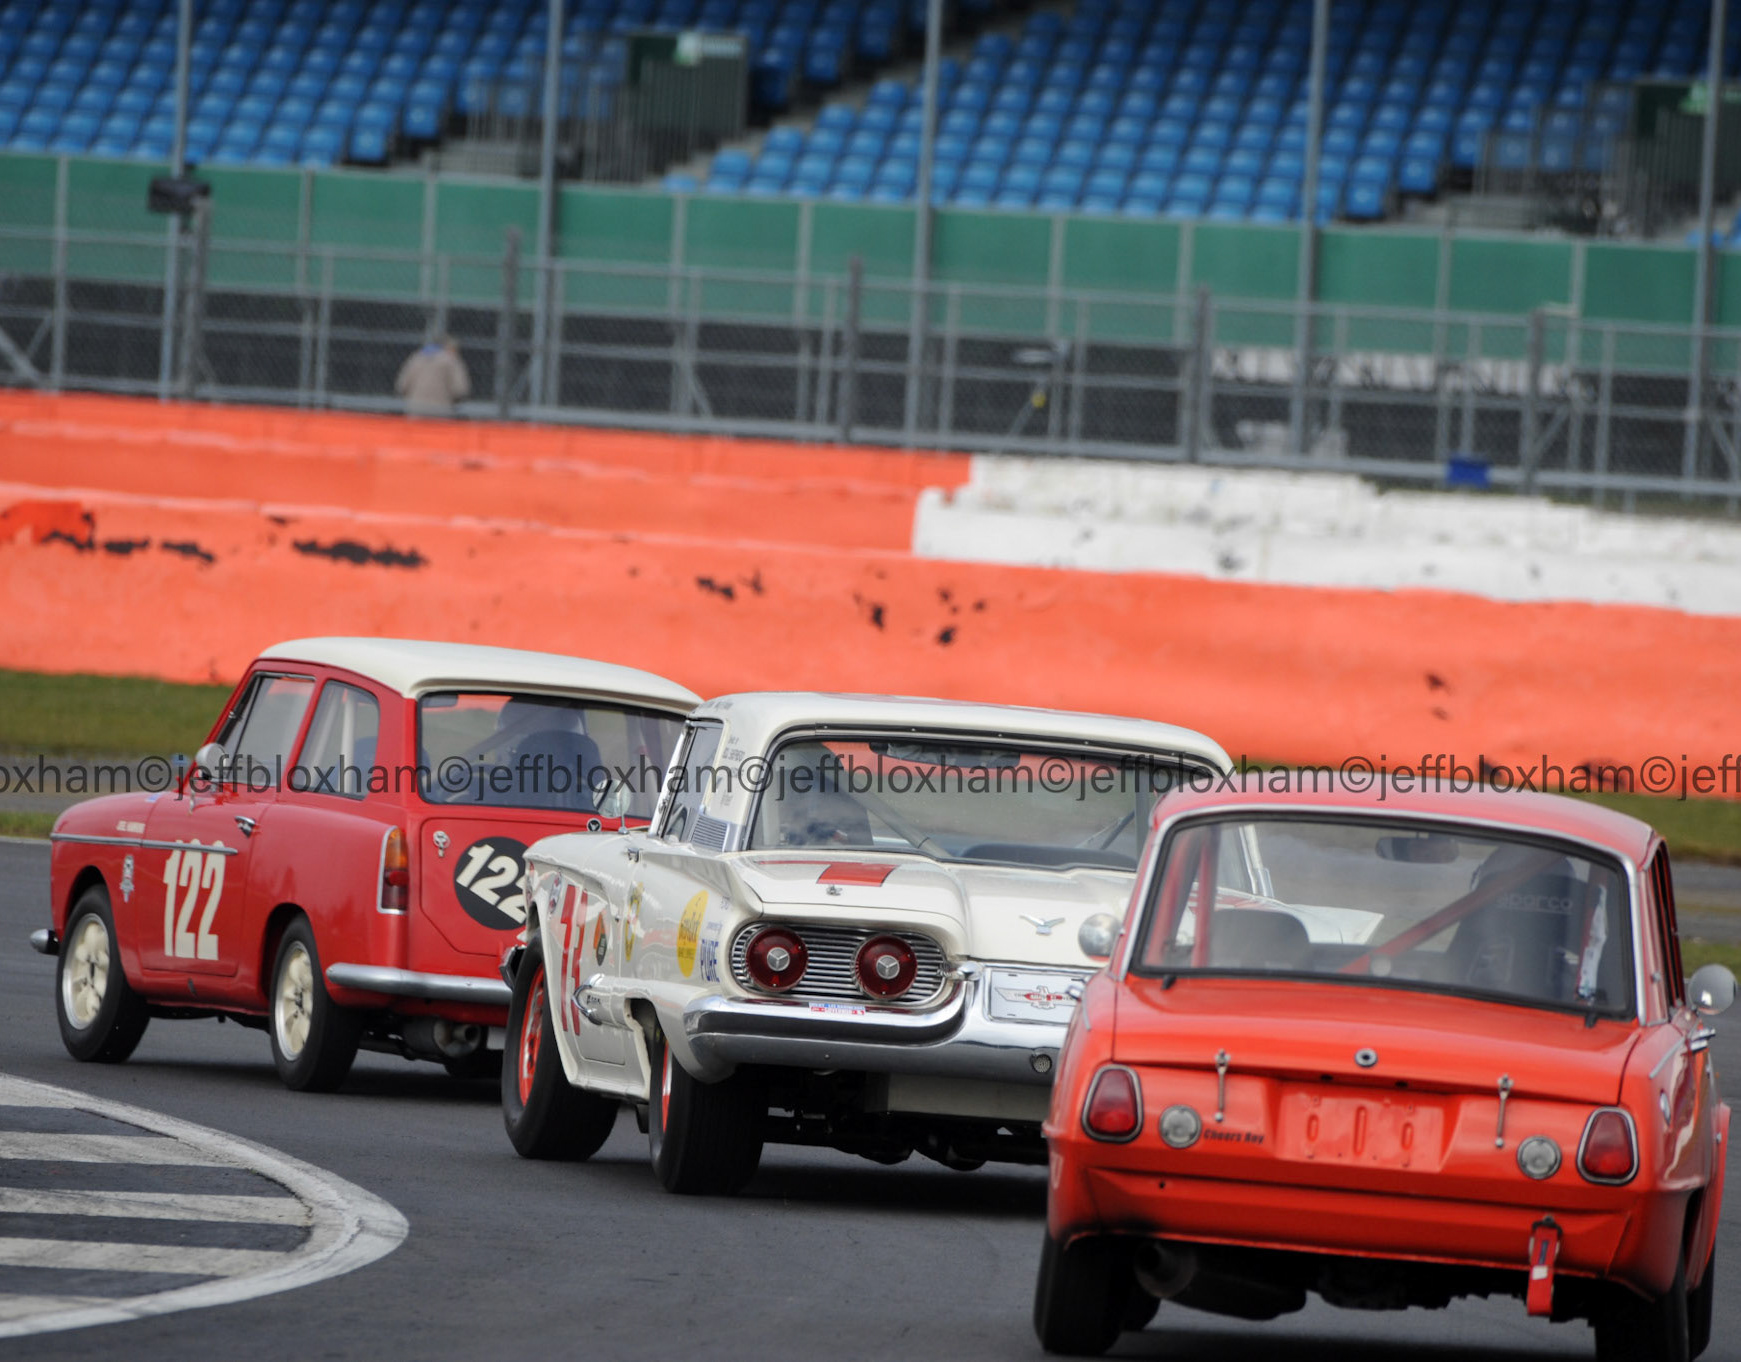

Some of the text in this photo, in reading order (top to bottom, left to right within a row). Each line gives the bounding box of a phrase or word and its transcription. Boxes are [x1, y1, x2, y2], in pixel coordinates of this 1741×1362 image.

[162, 838, 226, 960] 122
[1204, 1128, 1266, 1145] Cheers Roy
